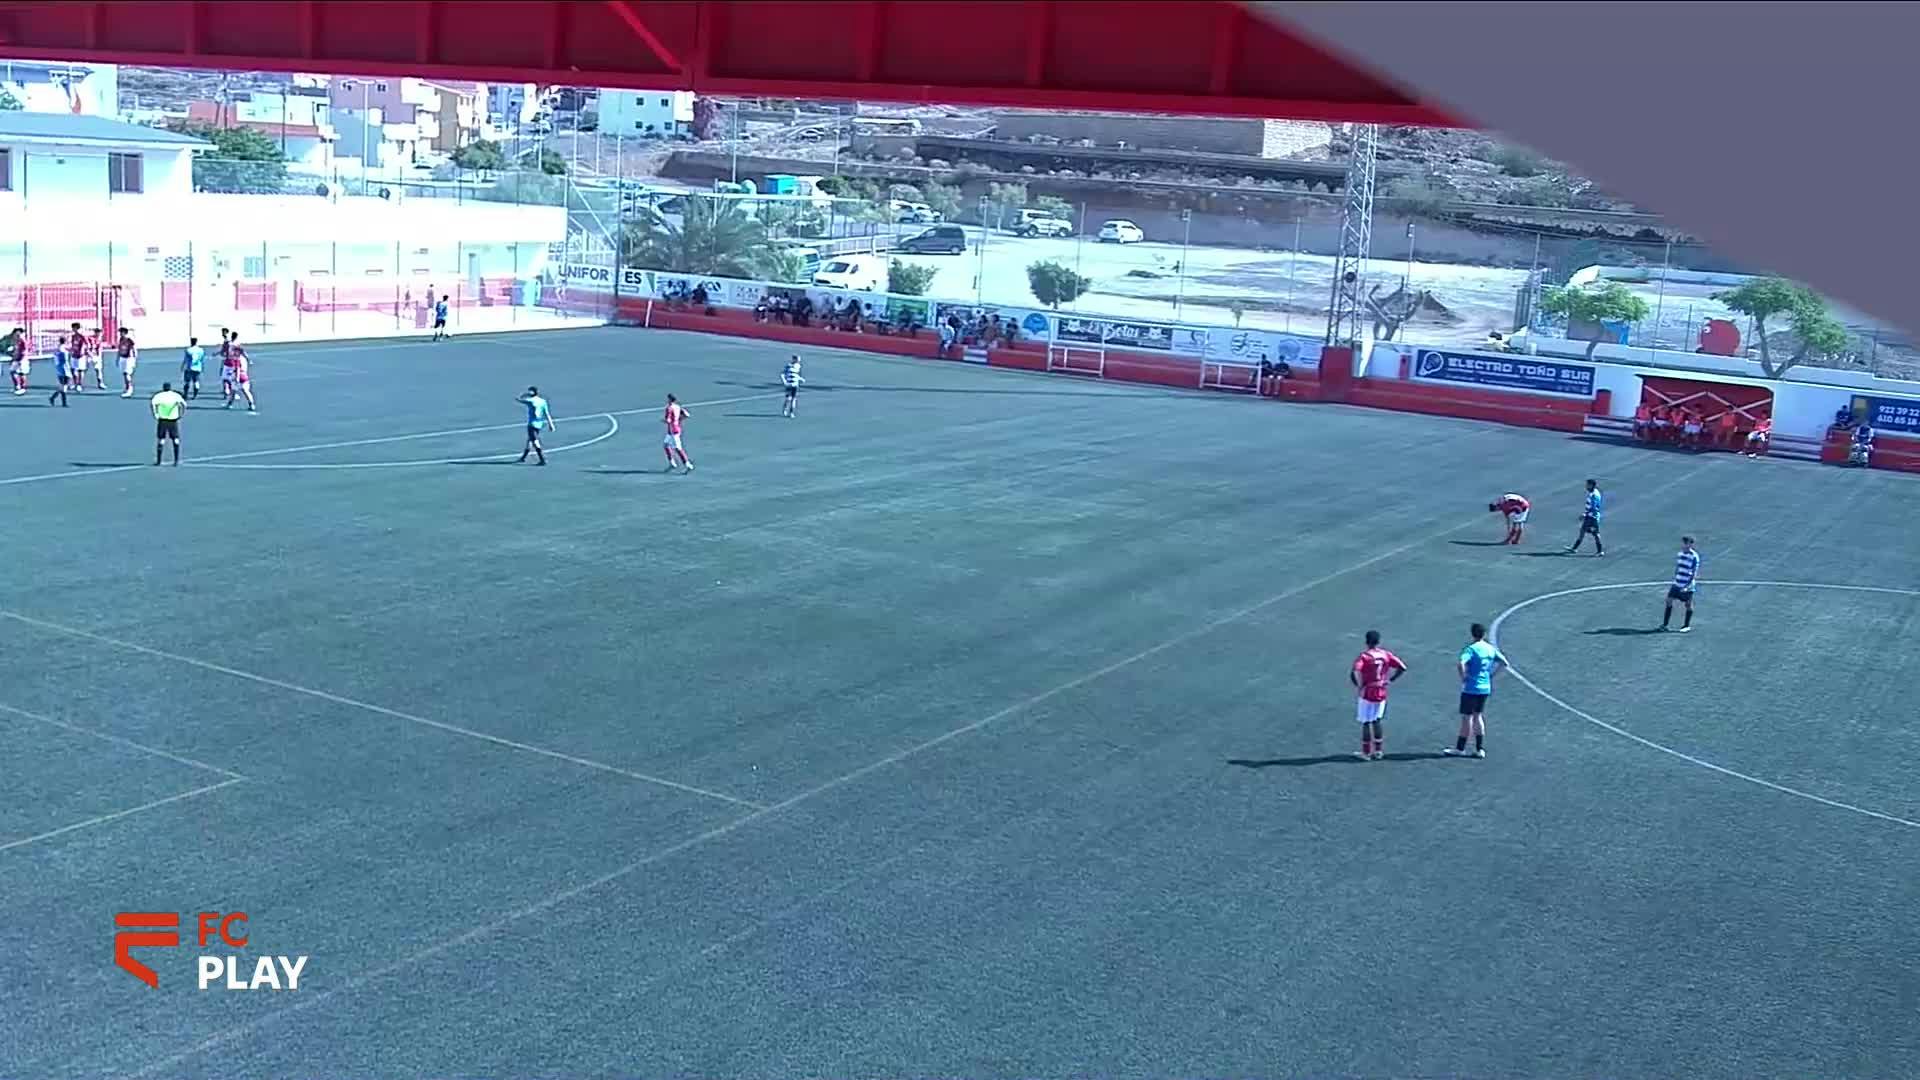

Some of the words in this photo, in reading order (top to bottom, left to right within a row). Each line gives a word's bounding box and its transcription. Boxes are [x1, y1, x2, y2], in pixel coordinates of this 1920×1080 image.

[558, 264, 642, 284] UNIFORES
[1448, 357, 1513, 372] ELECTRO
[1517, 363, 1556, 377] TOÑO
[1560, 369, 1591, 381] SUR
